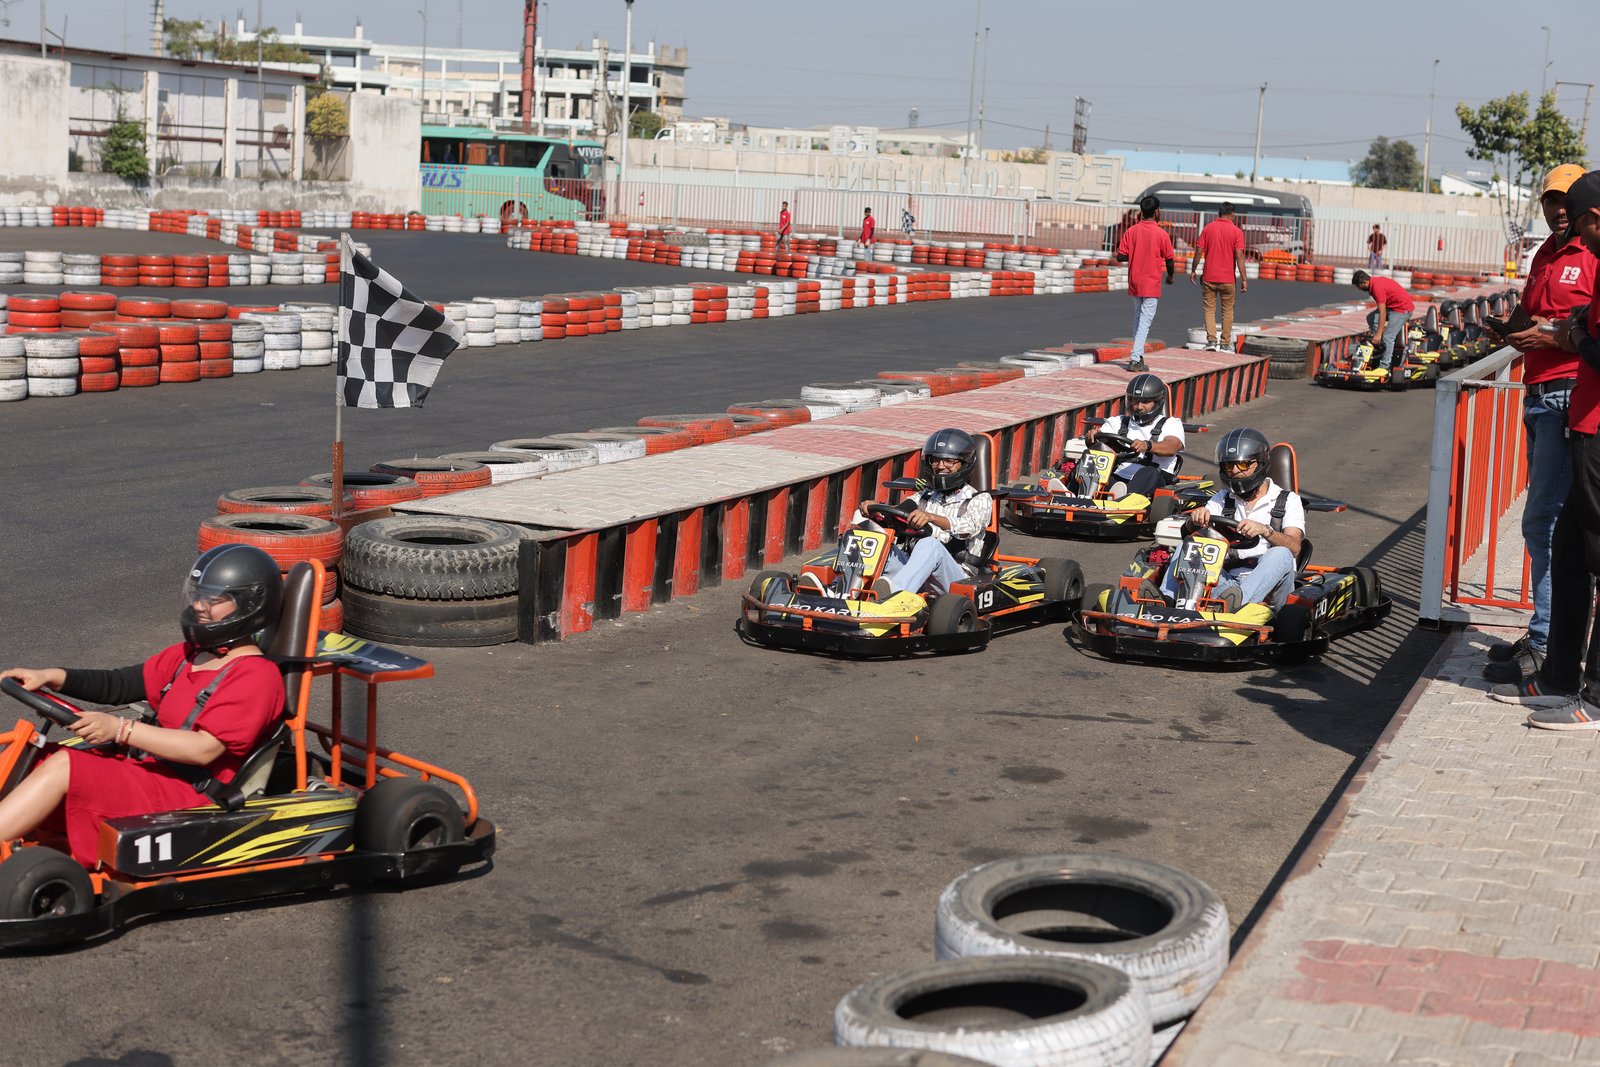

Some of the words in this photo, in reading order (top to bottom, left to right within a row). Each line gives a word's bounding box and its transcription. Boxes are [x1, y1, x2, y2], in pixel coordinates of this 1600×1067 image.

[1560, 265, 1581, 280] F9
[1082, 454, 1109, 471] F9
[843, 535, 879, 558] F9
[1183, 542, 1220, 565] F9
[978, 590, 994, 610] 19
[1141, 613, 1164, 621] GO
[134, 832, 172, 864] 11
